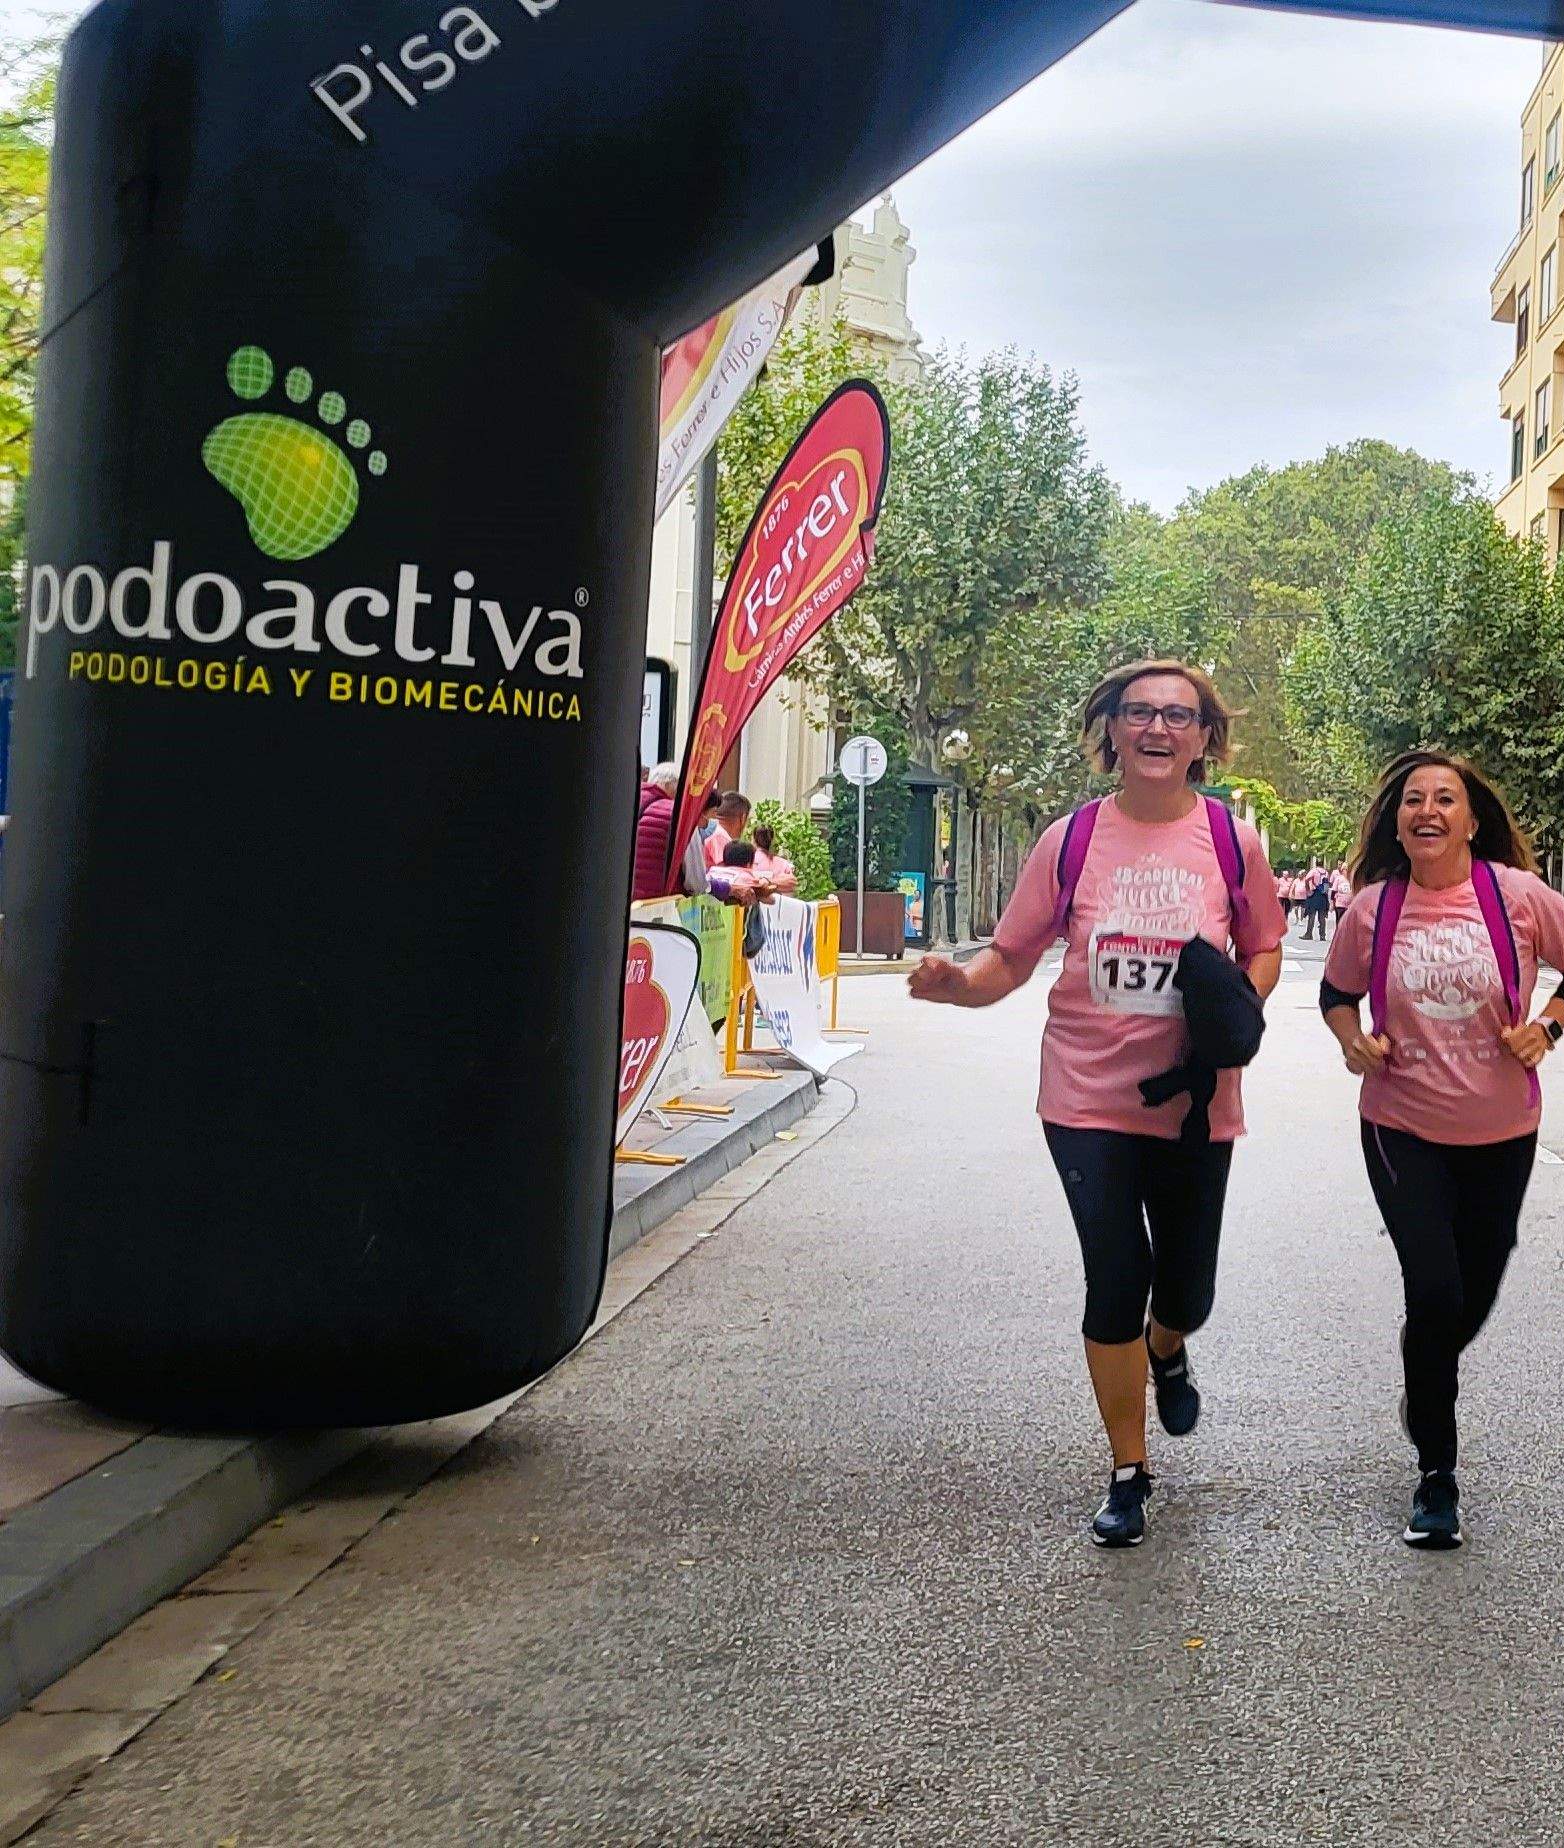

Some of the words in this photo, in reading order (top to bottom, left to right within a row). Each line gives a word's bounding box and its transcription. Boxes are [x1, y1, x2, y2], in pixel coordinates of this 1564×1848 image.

[308, 6, 501, 142] Pisa
[742, 469, 851, 638] Ferrer
[762, 494, 789, 540] 1876
[26, 540, 585, 679] podoactiva
[69, 650, 271, 695] PODOLOGÍA
[290, 668, 312, 698] Y
[329, 671, 582, 722] BIOMECÁNICA
[1102, 956, 1174, 993] 137
